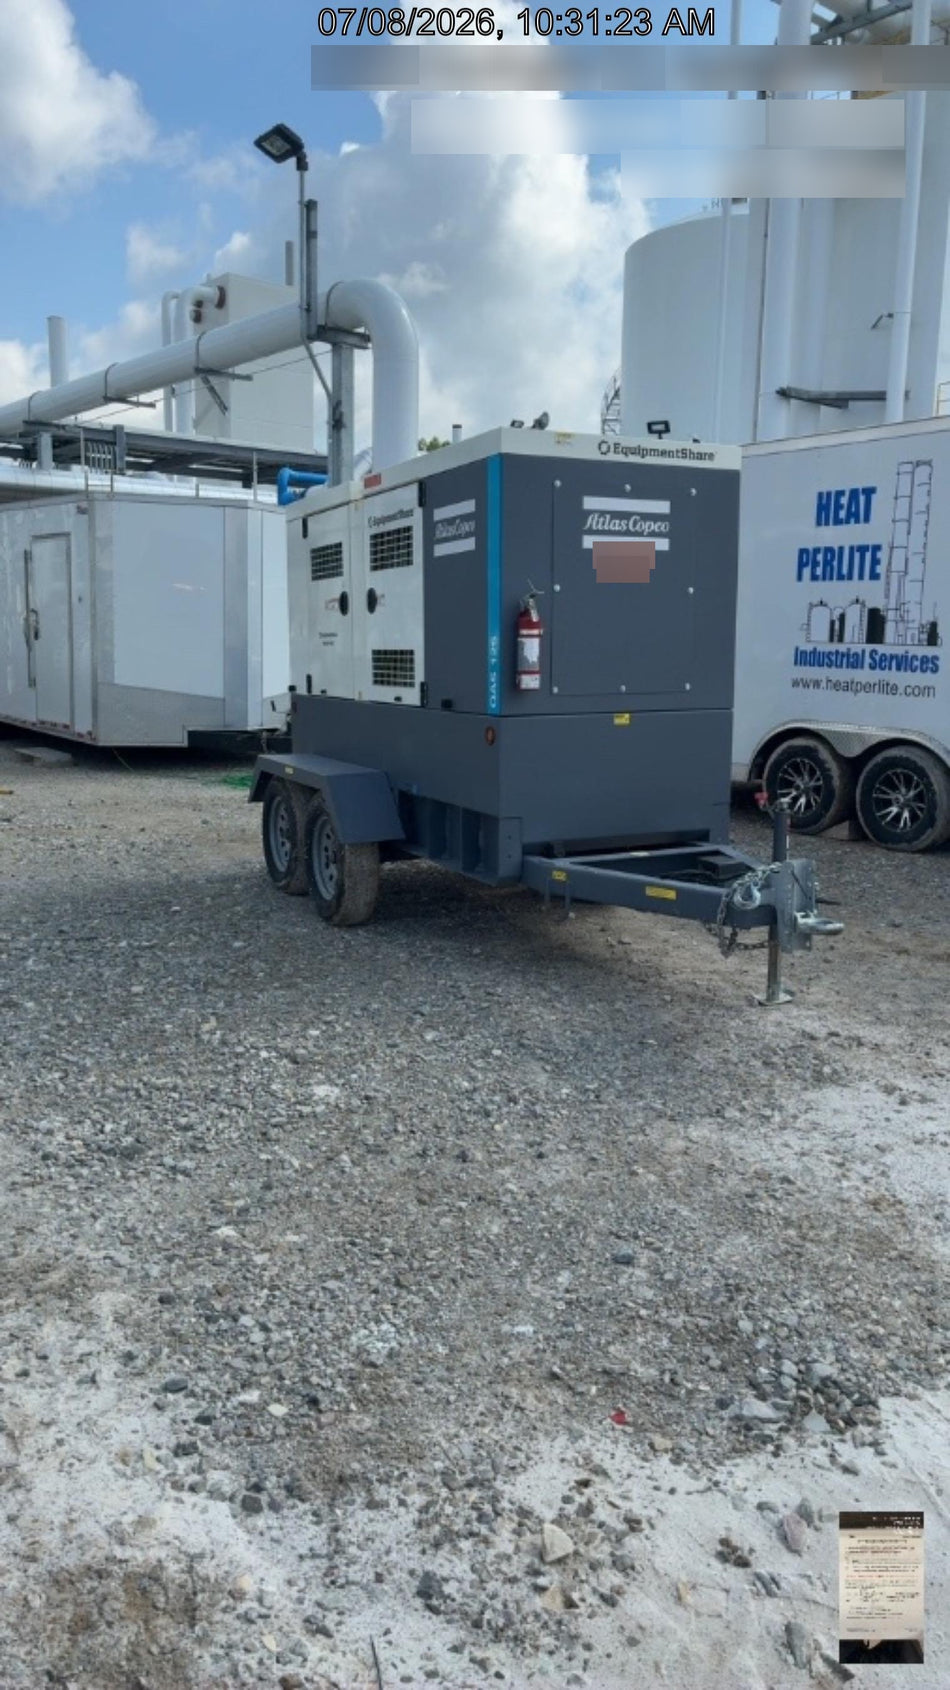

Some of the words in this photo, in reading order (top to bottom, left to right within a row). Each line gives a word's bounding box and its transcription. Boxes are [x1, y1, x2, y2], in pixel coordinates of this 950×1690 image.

[613, 442, 715, 461] EquipmentShare
[816, 487, 876, 526] HEAT
[796, 544, 882, 582] PERLITE
[794, 646, 865, 670] Industrial
[868, 649, 940, 674] Services
[791, 676, 936, 698] www.heatperlite.com
